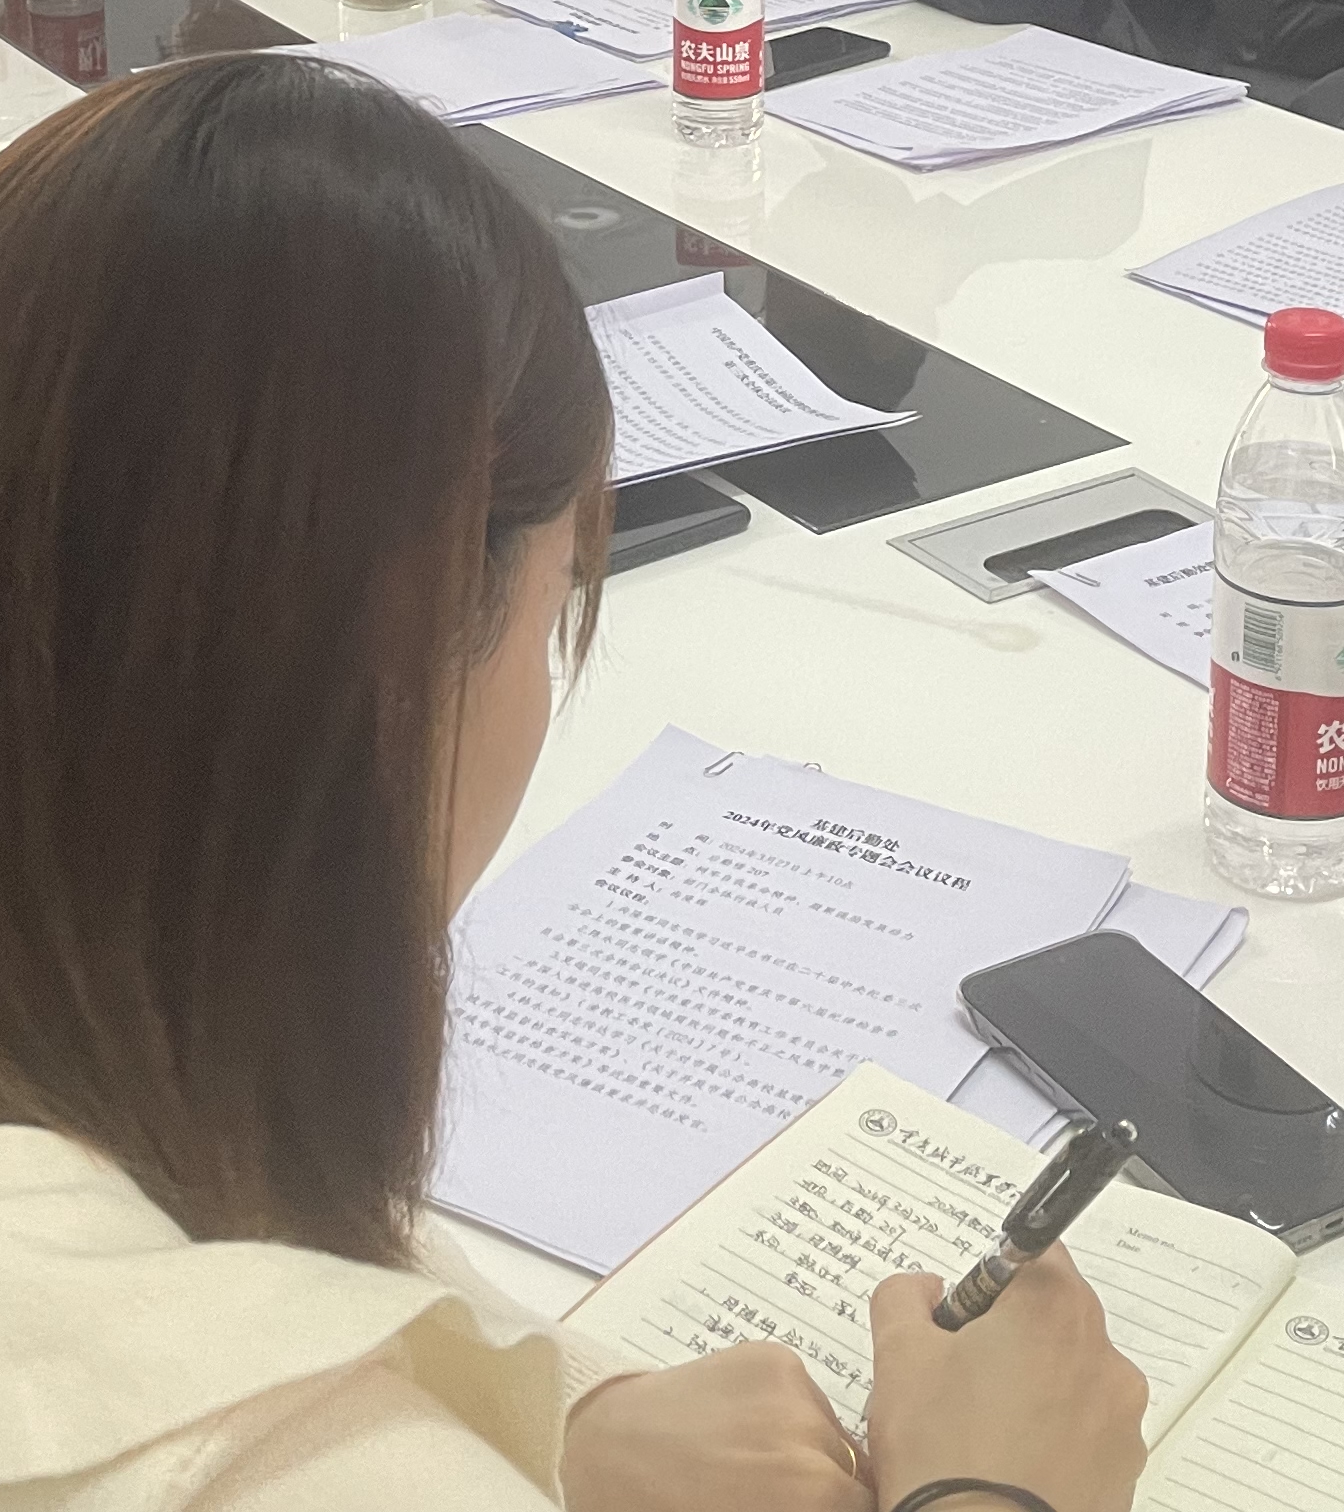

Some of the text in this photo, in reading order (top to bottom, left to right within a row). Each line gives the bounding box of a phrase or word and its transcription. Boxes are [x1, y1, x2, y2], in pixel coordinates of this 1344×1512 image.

[681, 40, 750, 62] 农夫山泉
[681, 60, 750, 74] NONGFU SPRING
[807, 818, 901, 853] 基建后勤处
[722, 811, 971, 892] 2024年党风廉政专题会会议议程
[1116, 1239, 1140, 1252] Date
